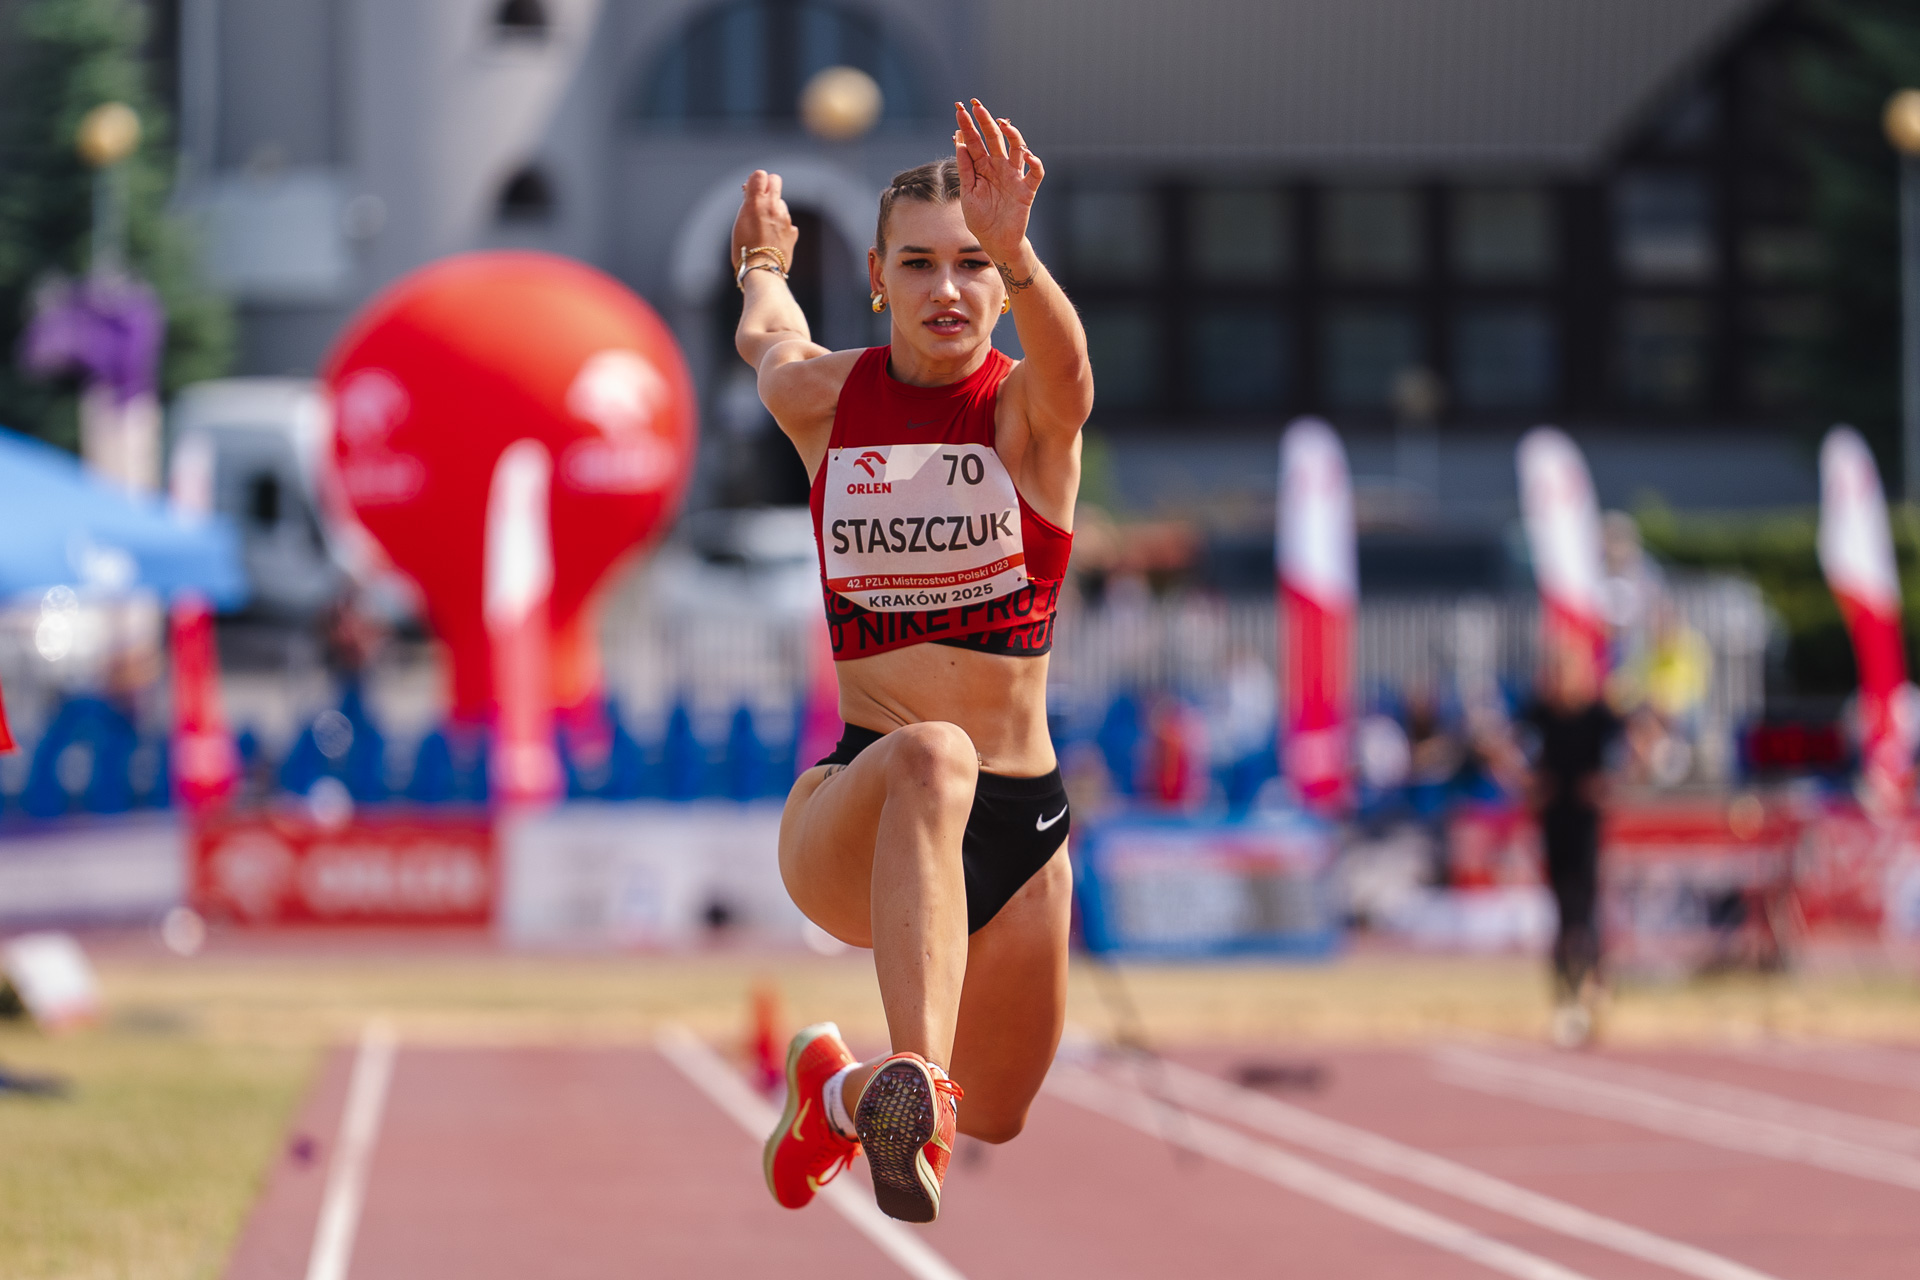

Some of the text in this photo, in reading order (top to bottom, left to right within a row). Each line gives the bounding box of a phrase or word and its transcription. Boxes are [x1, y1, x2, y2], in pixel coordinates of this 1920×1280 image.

[942, 453, 985, 486] 70
[846, 482, 892, 495] ORLEN
[831, 510, 1014, 555] STASZCZUK
[846, 559, 1009, 589] 42. PZLA Mistrzostwa Polski U23
[868, 583, 994, 608] KRAKÓW 2025
[857, 609, 950, 650] NIKE
[961, 584, 1036, 627] PRO
